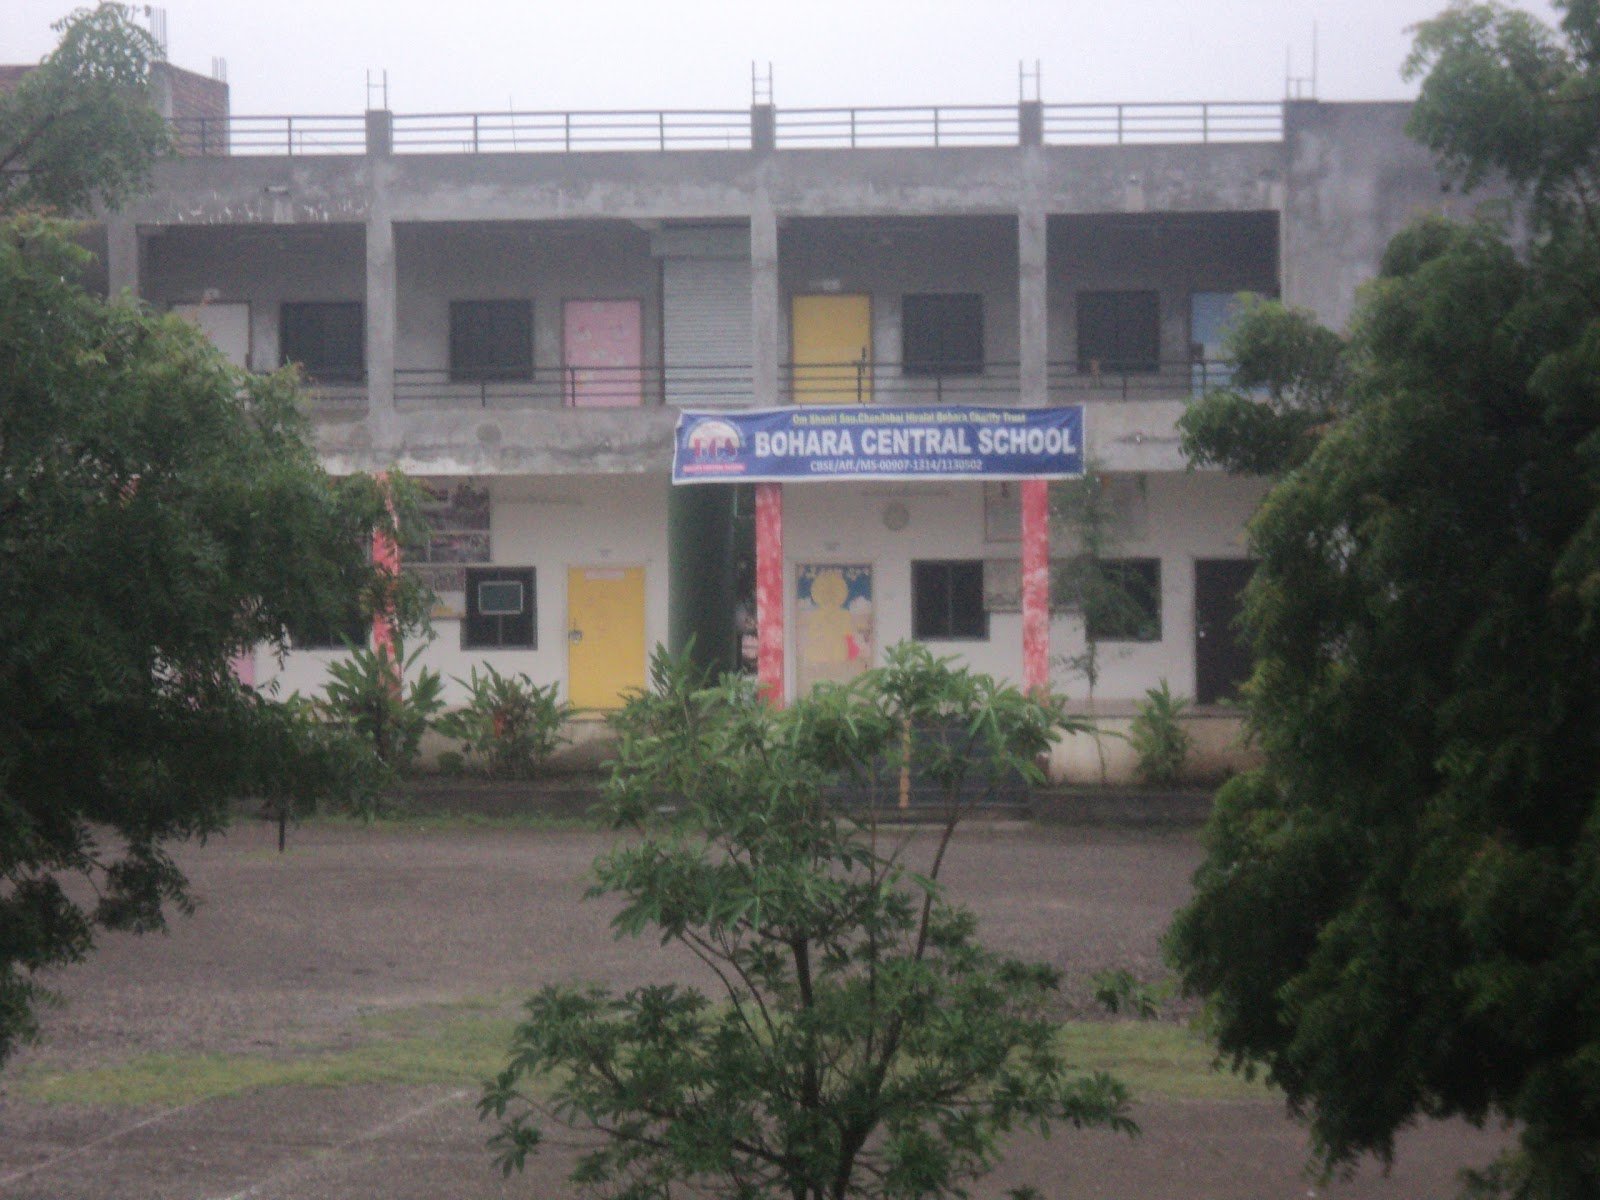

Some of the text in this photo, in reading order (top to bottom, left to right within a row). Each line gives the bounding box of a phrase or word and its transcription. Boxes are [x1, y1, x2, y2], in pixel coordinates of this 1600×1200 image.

[755, 430, 854, 457] BOHARA
[861, 428, 971, 456] CENTRAL
[978, 427, 1076, 455] SCHOOL
